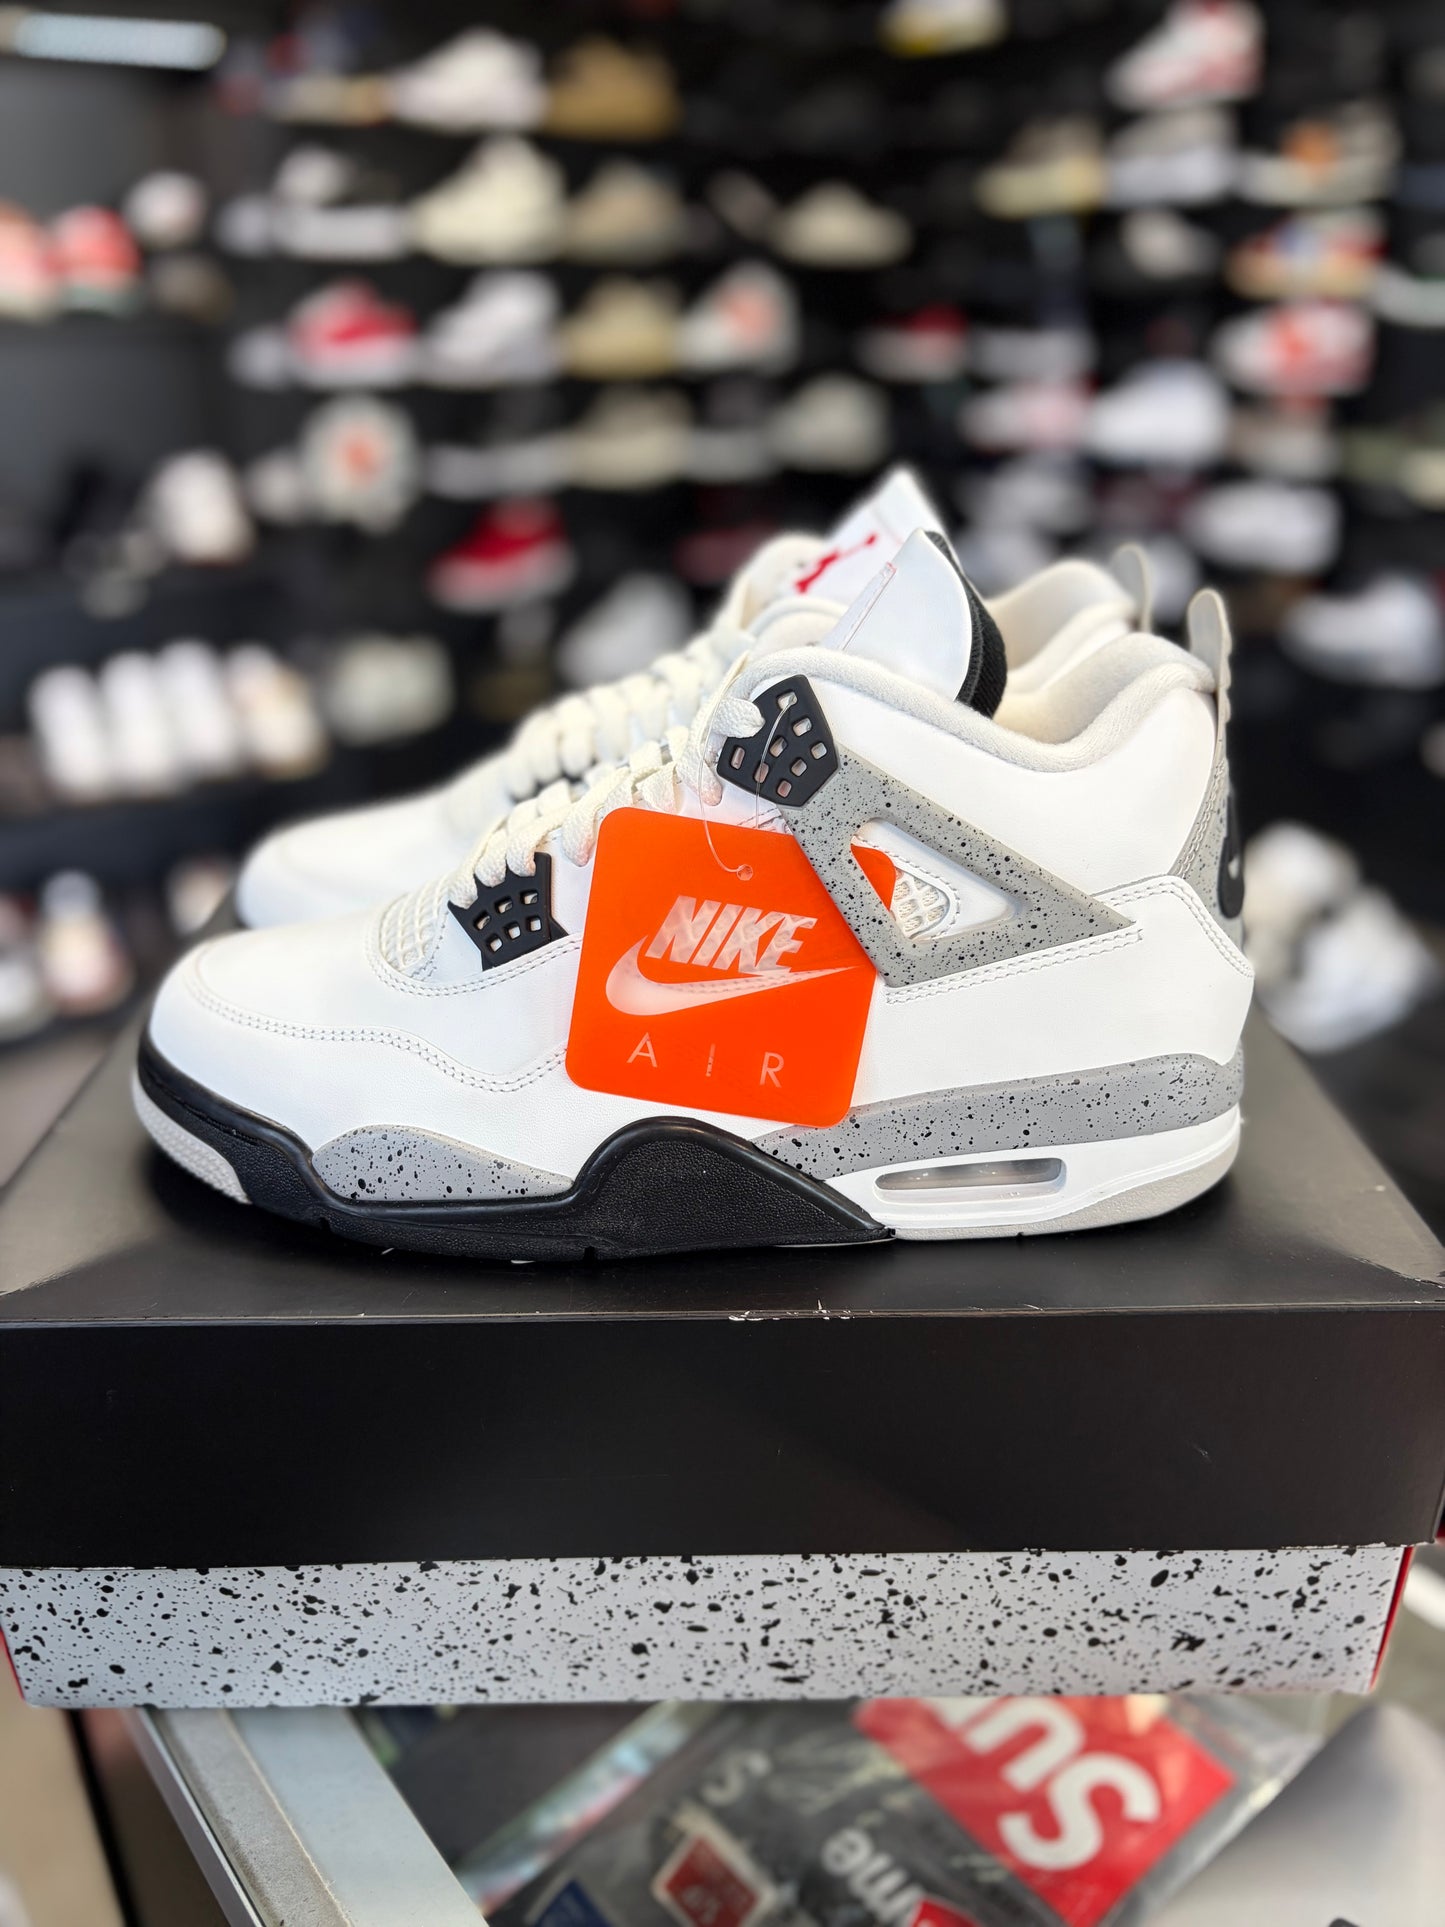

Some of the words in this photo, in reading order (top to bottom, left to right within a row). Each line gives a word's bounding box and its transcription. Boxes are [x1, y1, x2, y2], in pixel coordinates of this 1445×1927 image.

[645, 895, 818, 977] NIKE
[627, 1032, 785, 1088] AIR
[928, 1696, 1161, 1871] Su
[821, 1827, 928, 1922] me
